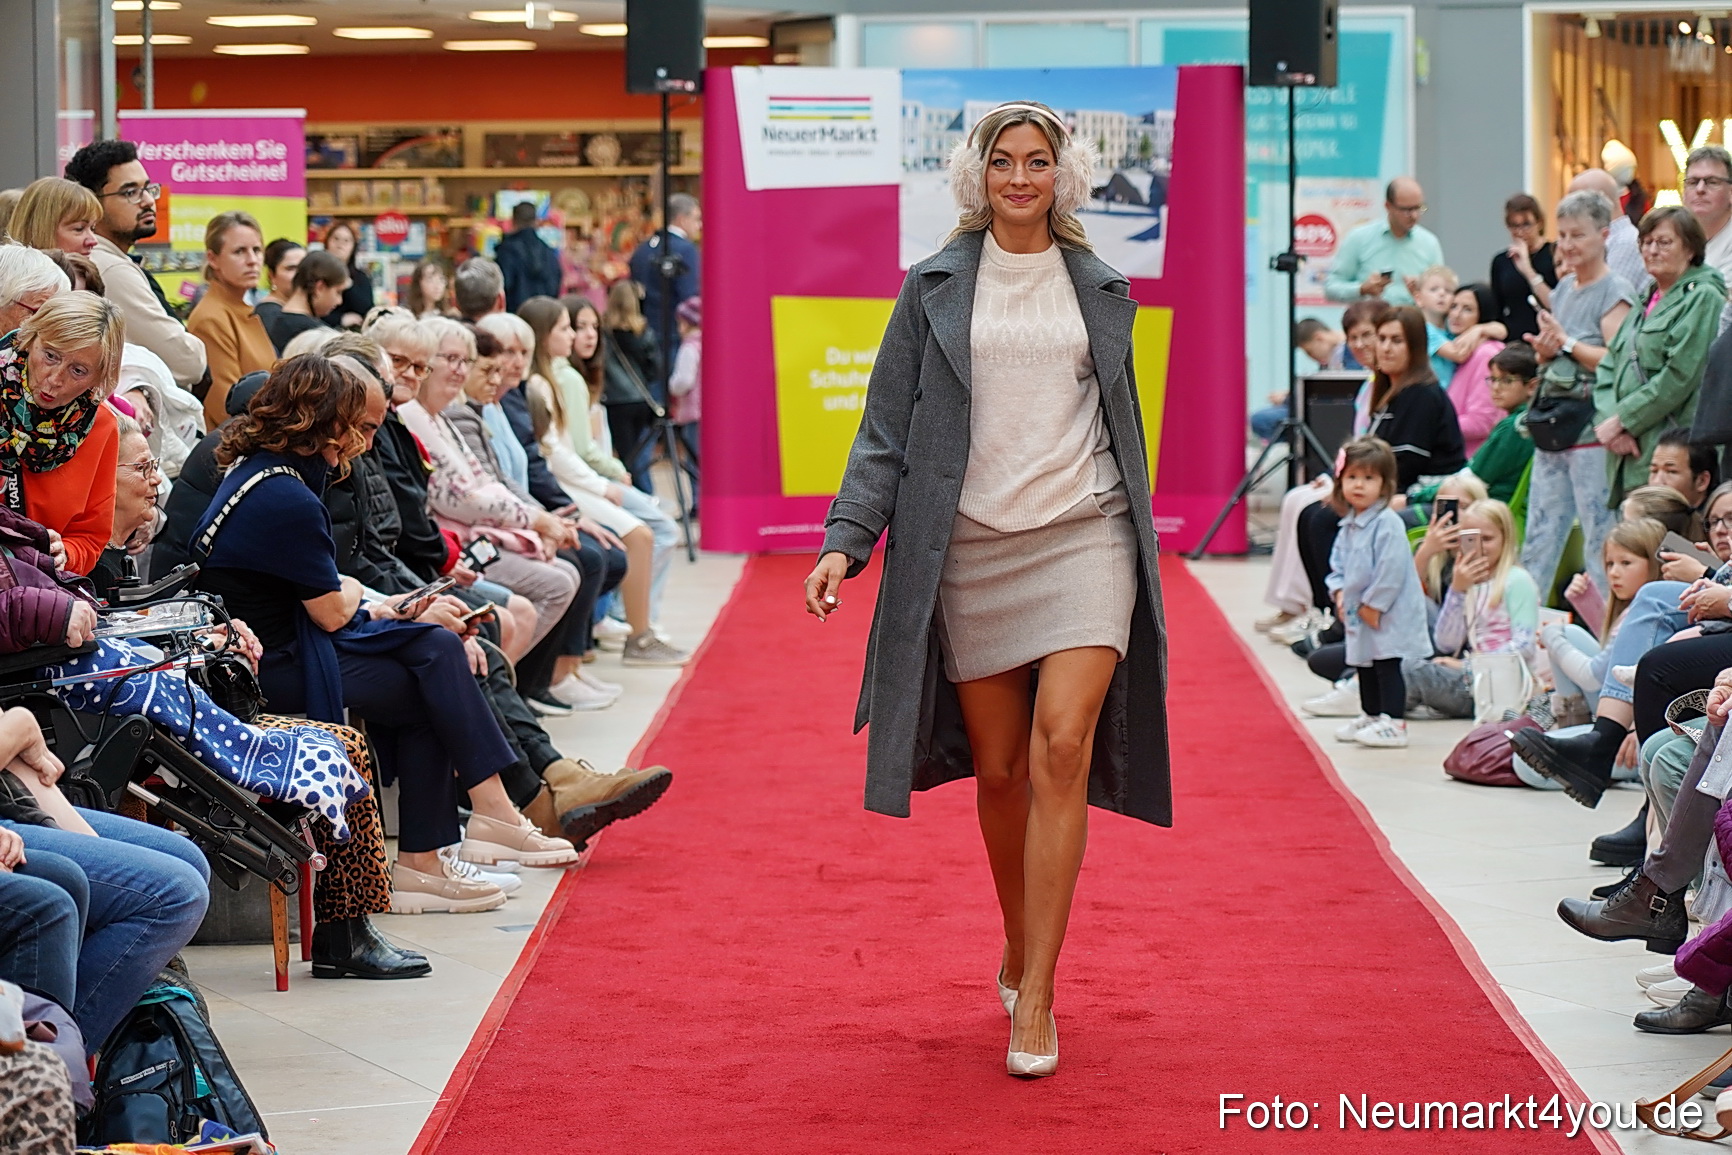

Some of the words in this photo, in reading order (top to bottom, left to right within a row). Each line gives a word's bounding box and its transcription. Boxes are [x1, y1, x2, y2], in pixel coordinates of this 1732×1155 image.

[762, 126, 878, 142] NeuerMarkt
[133, 140, 253, 160] Verschenken
[254, 139, 287, 160] Sie
[171, 161, 288, 182] Gutscheine!
[853, 347, 878, 364] wi
[9, 474, 20, 508] KARL
